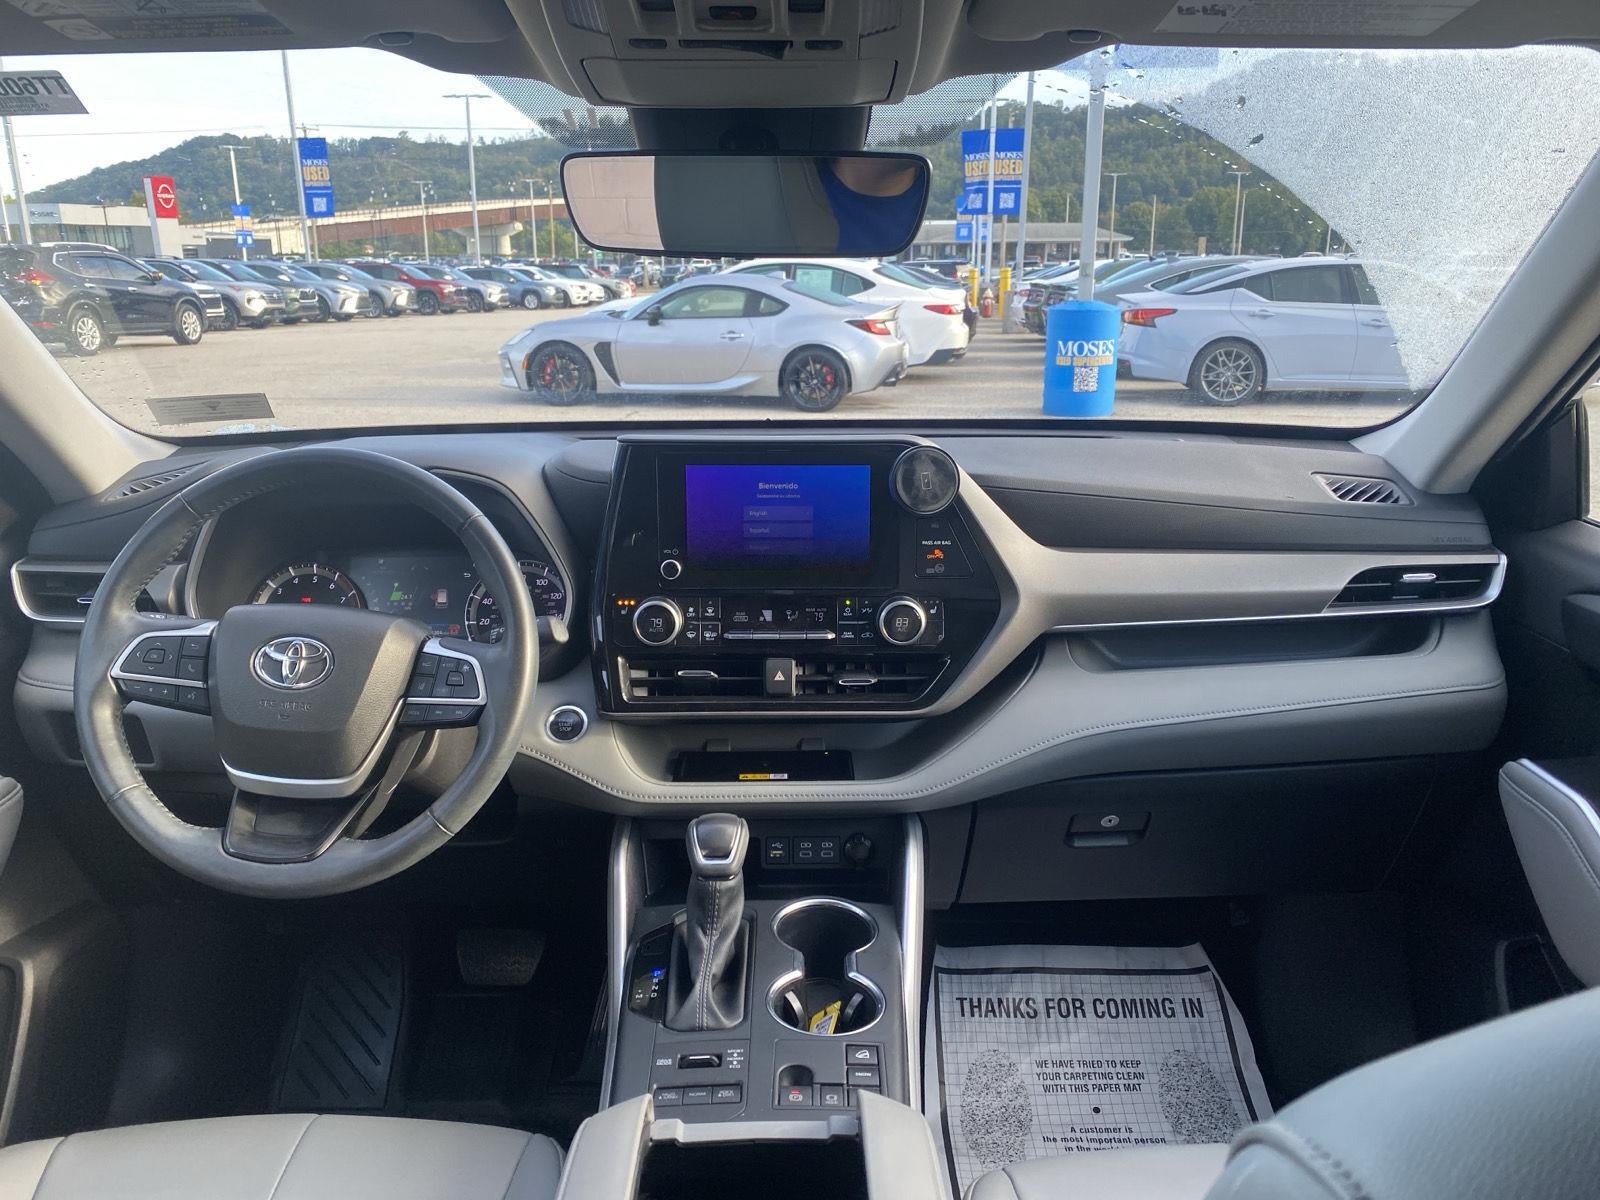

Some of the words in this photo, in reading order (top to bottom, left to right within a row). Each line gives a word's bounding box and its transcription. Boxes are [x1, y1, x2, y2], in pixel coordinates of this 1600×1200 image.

[965, 160, 989, 176] USED
[995, 160, 1022, 175] USED
[304, 166, 329, 181] USED
[1057, 340, 1114, 357] MOSES
[758, 482, 799, 490] Bienvenido
[650, 618, 663, 628] 79
[896, 617, 909, 627] 83
[955, 997, 1038, 1019] THANKS
[1045, 997, 1086, 1019] FOR
[1092, 997, 1176, 1019] COMING
[1181, 997, 1205, 1018] IN
[1035, 1060, 1049, 1069] WE
[1051, 1060, 1075, 1069] HAVE
[1076, 1060, 1103, 1069] TRIED
[1105, 1060, 1117, 1069] TO
[1119, 1060, 1142, 1069] KEEP
[1035, 1072, 1061, 1081] YOUR
[1063, 1072, 1113, 1081] CARPETING
[1115, 1072, 1145, 1081] CLEAN
[1042, 1084, 1066, 1093] WITH
[1068, 1084, 1089, 1093] THIS
[1091, 1084, 1121, 1093] PAPER
[1123, 1083, 1143, 1092] MAT
[1070, 1126, 1077, 1134] A
[1079, 1126, 1121, 1134] customer
[1124, 1126, 1134, 1134] is
[1042, 1135, 1058, 1143] the
[1085, 1136, 1132, 1145] important
[1133, 1137, 1167, 1145] person
